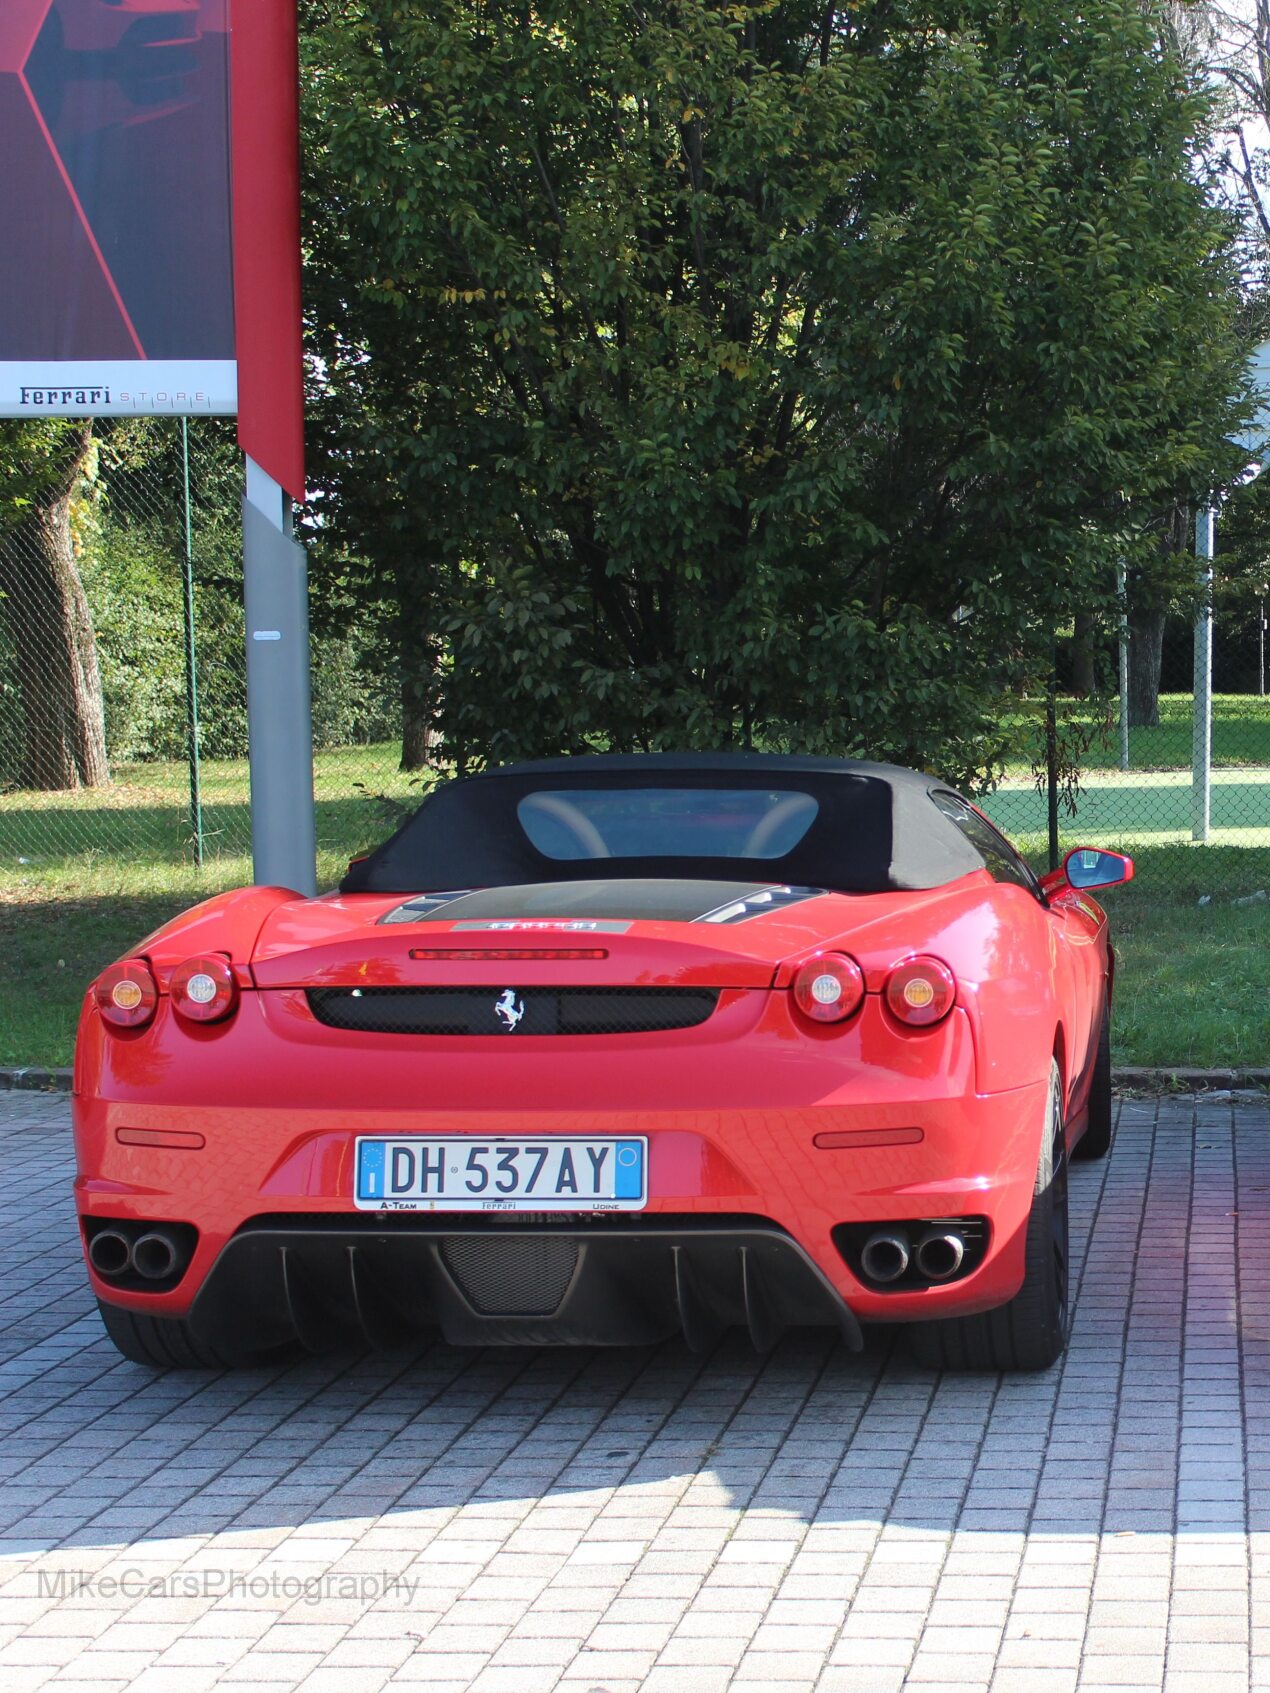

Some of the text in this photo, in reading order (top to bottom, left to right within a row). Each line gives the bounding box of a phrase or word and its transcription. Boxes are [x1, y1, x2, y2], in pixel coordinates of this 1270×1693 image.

[20, 386, 111, 404] Ferrari
[391, 1147, 446, 1193] DH
[465, 1147, 610, 1193] 537AY
